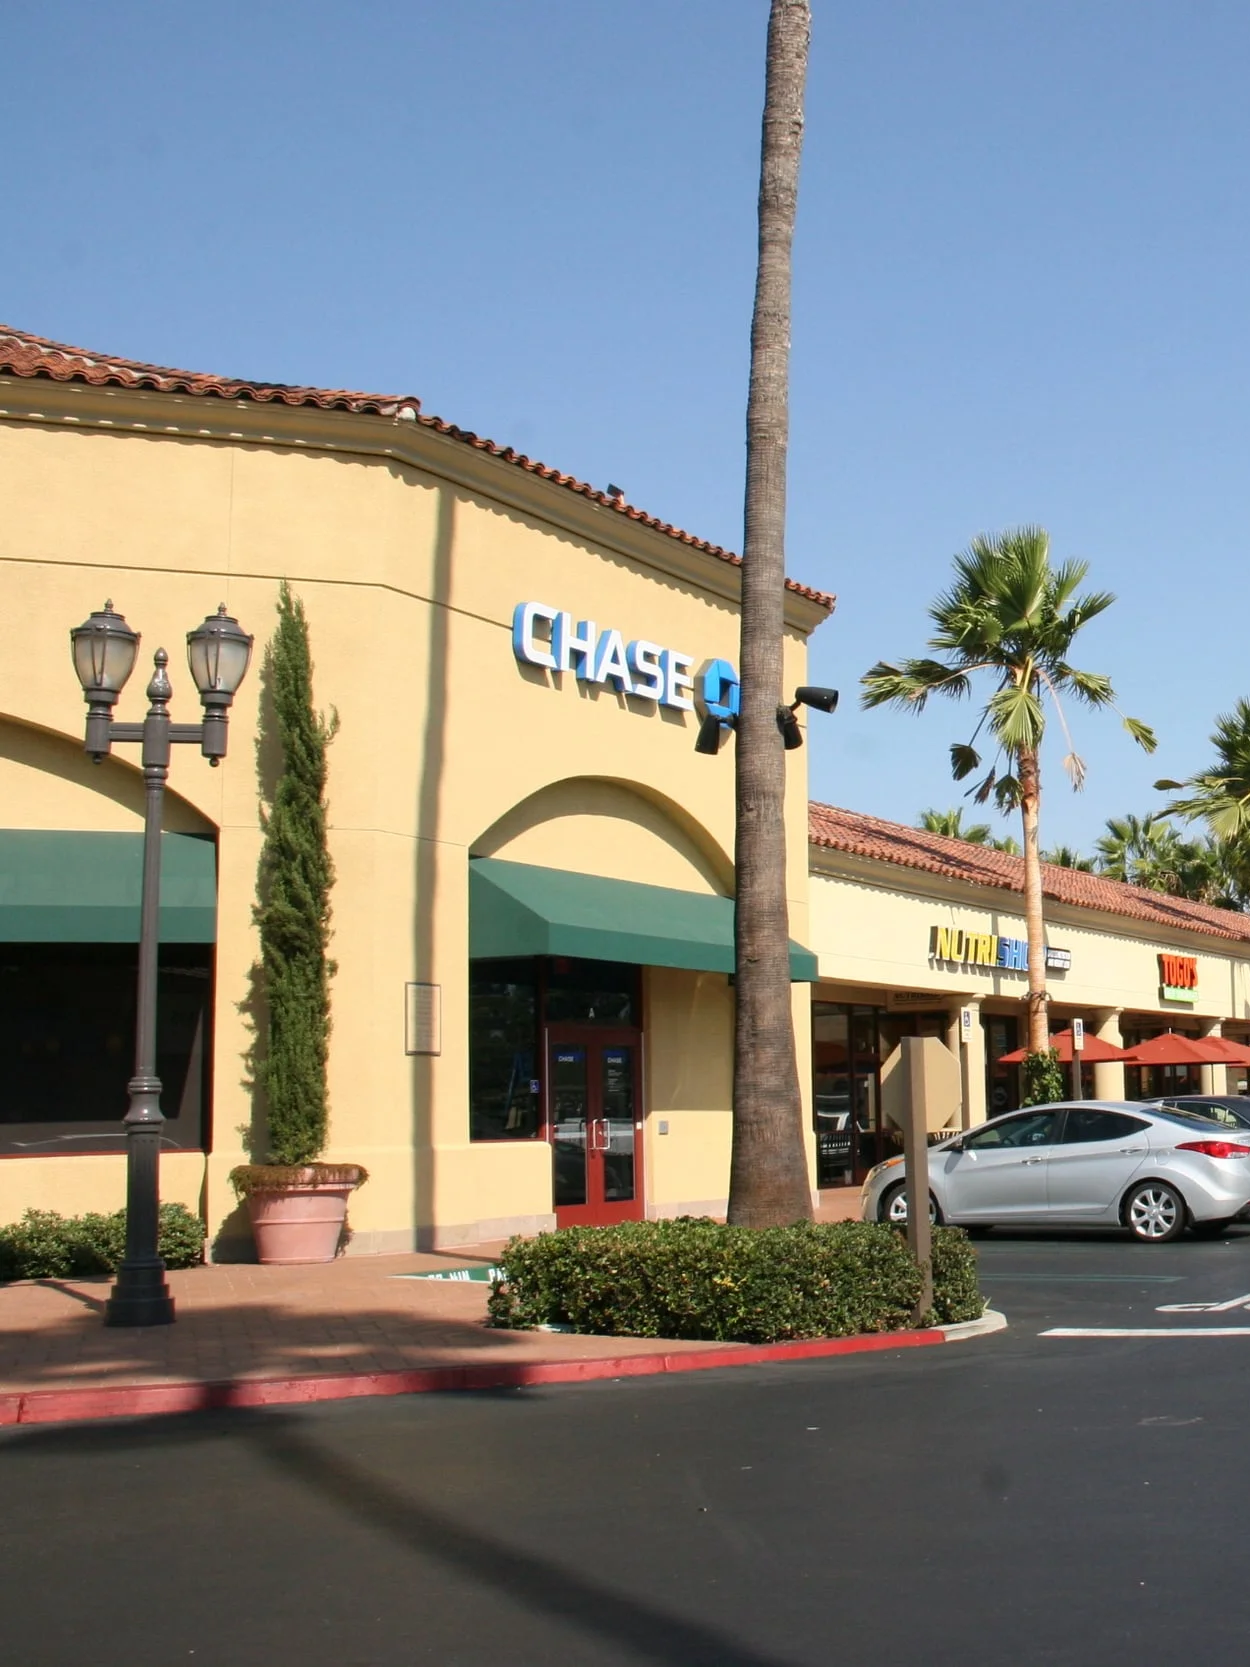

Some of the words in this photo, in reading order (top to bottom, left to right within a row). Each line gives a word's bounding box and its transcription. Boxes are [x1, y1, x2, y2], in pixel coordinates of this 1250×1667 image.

[512, 601, 694, 711] CHASE
[932, 925, 1048, 972] NUTRISHO
[1162, 953, 1198, 987] TOGO'S
[588, 1007, 595, 1019] A
